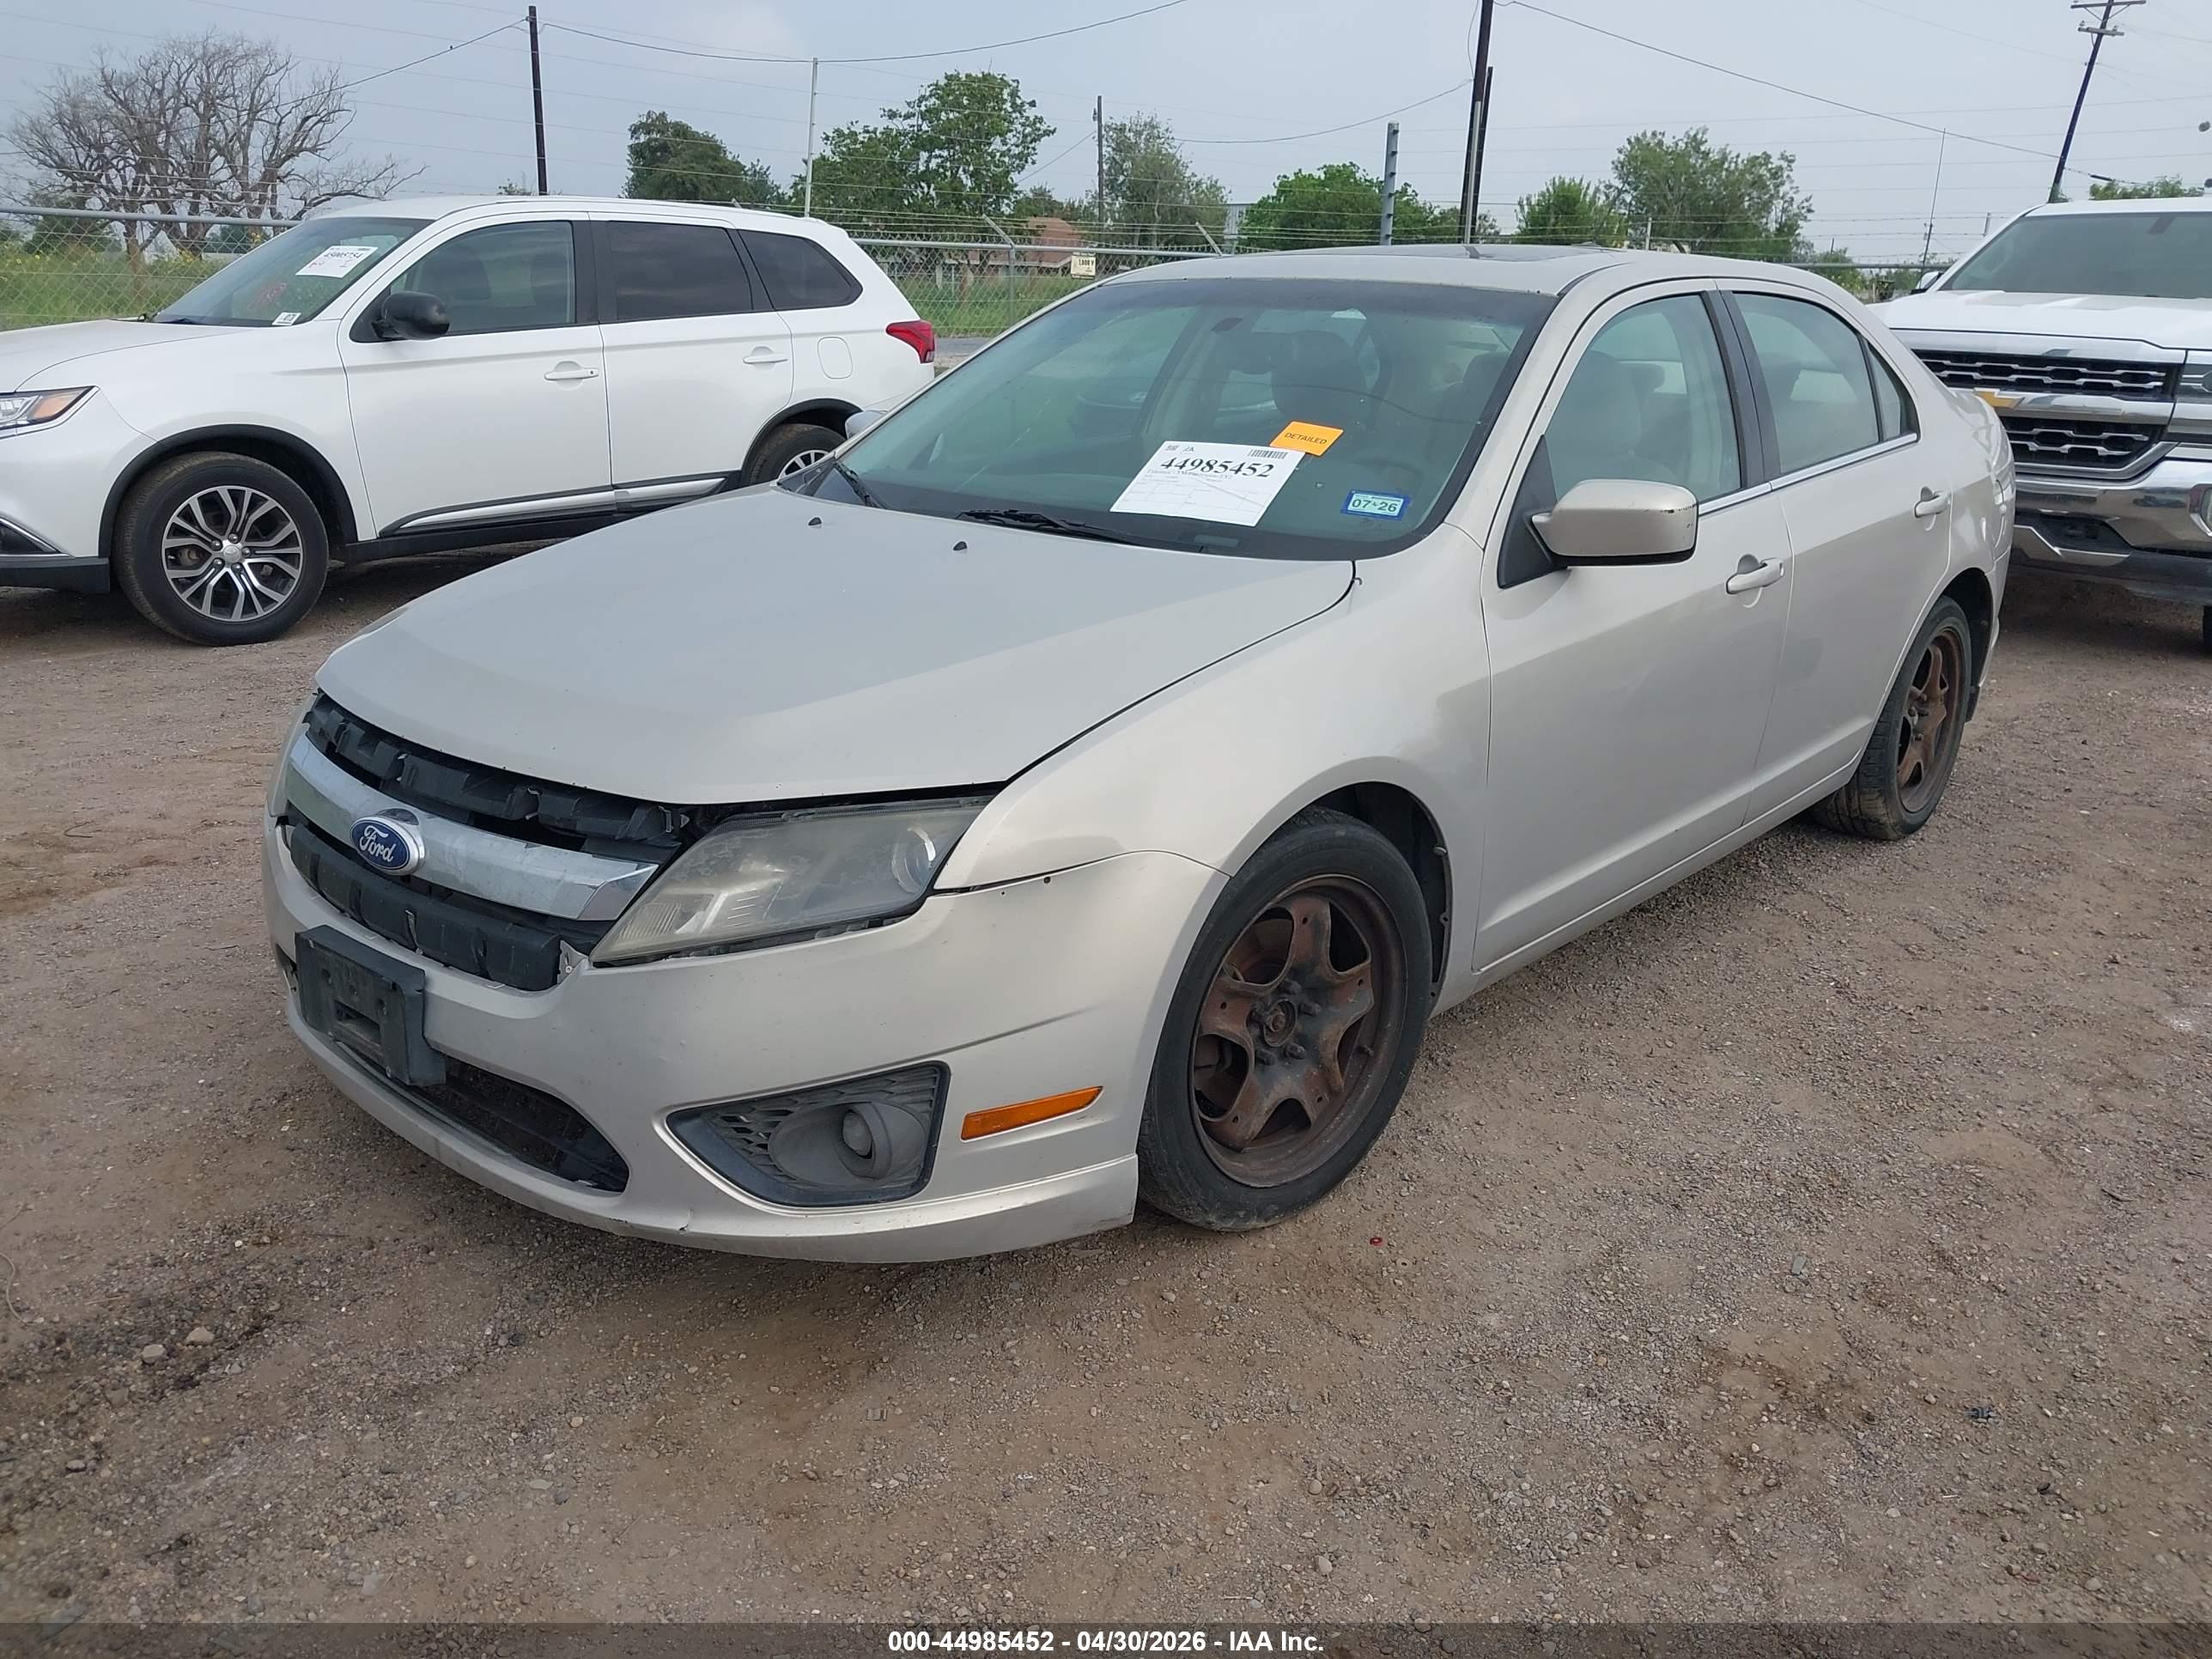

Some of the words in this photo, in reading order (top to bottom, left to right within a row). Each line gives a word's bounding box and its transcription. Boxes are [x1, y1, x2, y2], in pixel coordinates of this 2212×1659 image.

[1285, 432, 1328, 445] DETAILED
[1161, 457, 1275, 478] 44985452
[359, 825, 397, 862] Ford
